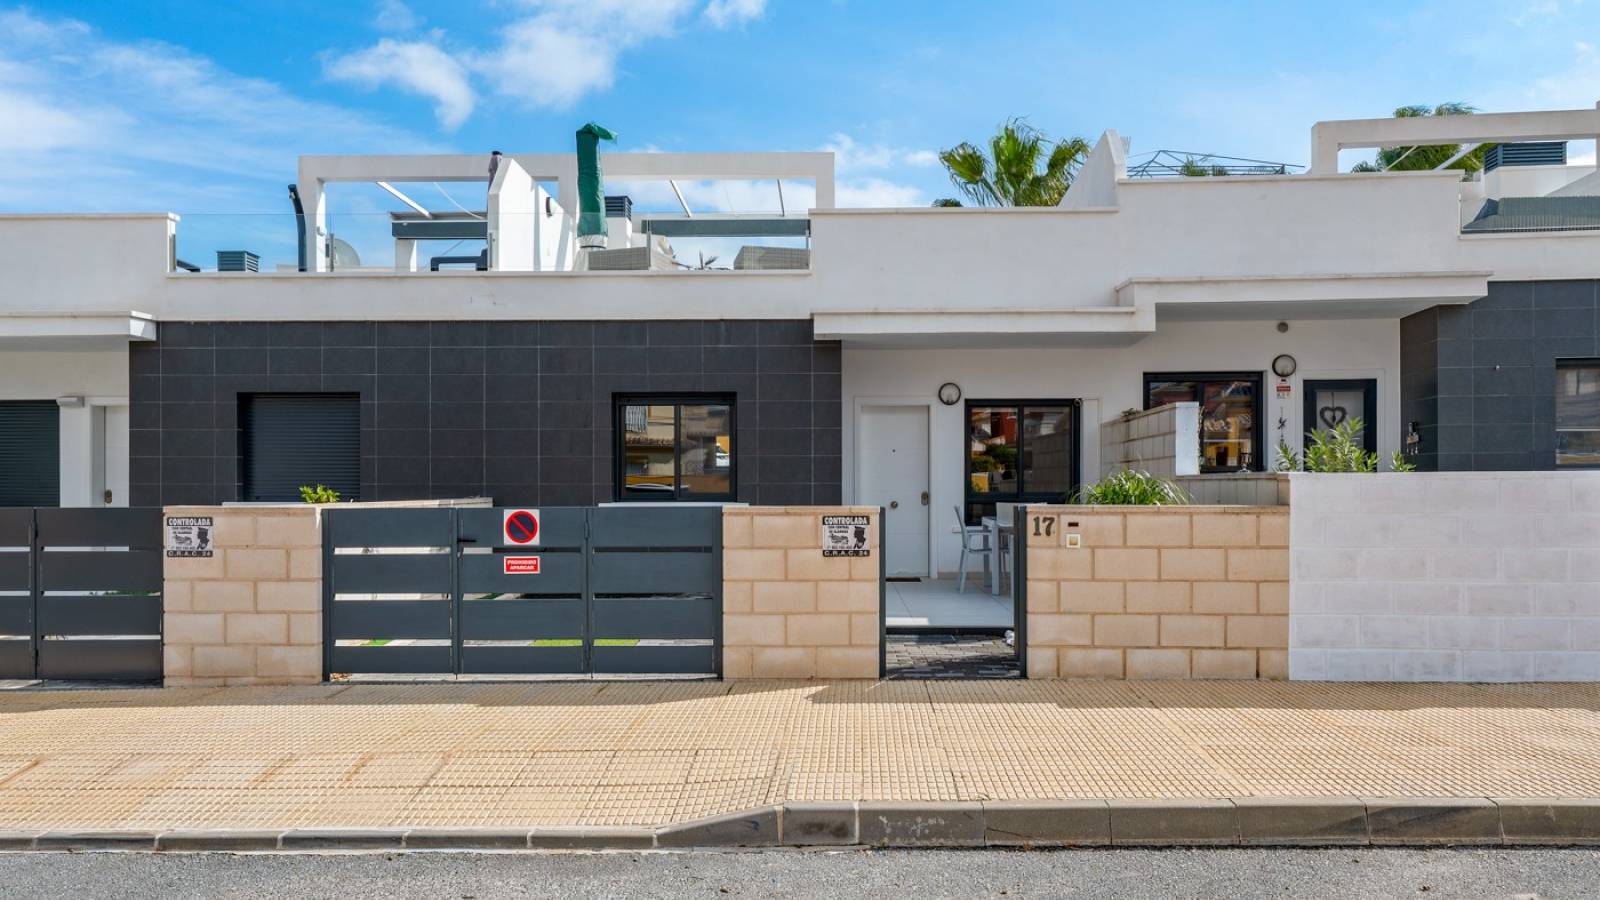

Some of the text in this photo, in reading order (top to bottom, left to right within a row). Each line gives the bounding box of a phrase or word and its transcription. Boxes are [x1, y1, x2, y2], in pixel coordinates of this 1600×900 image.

[168, 517, 212, 526] CONTROLADA
[823, 516, 867, 525] CONTROLADA
[1033, 516, 1055, 537] 17
